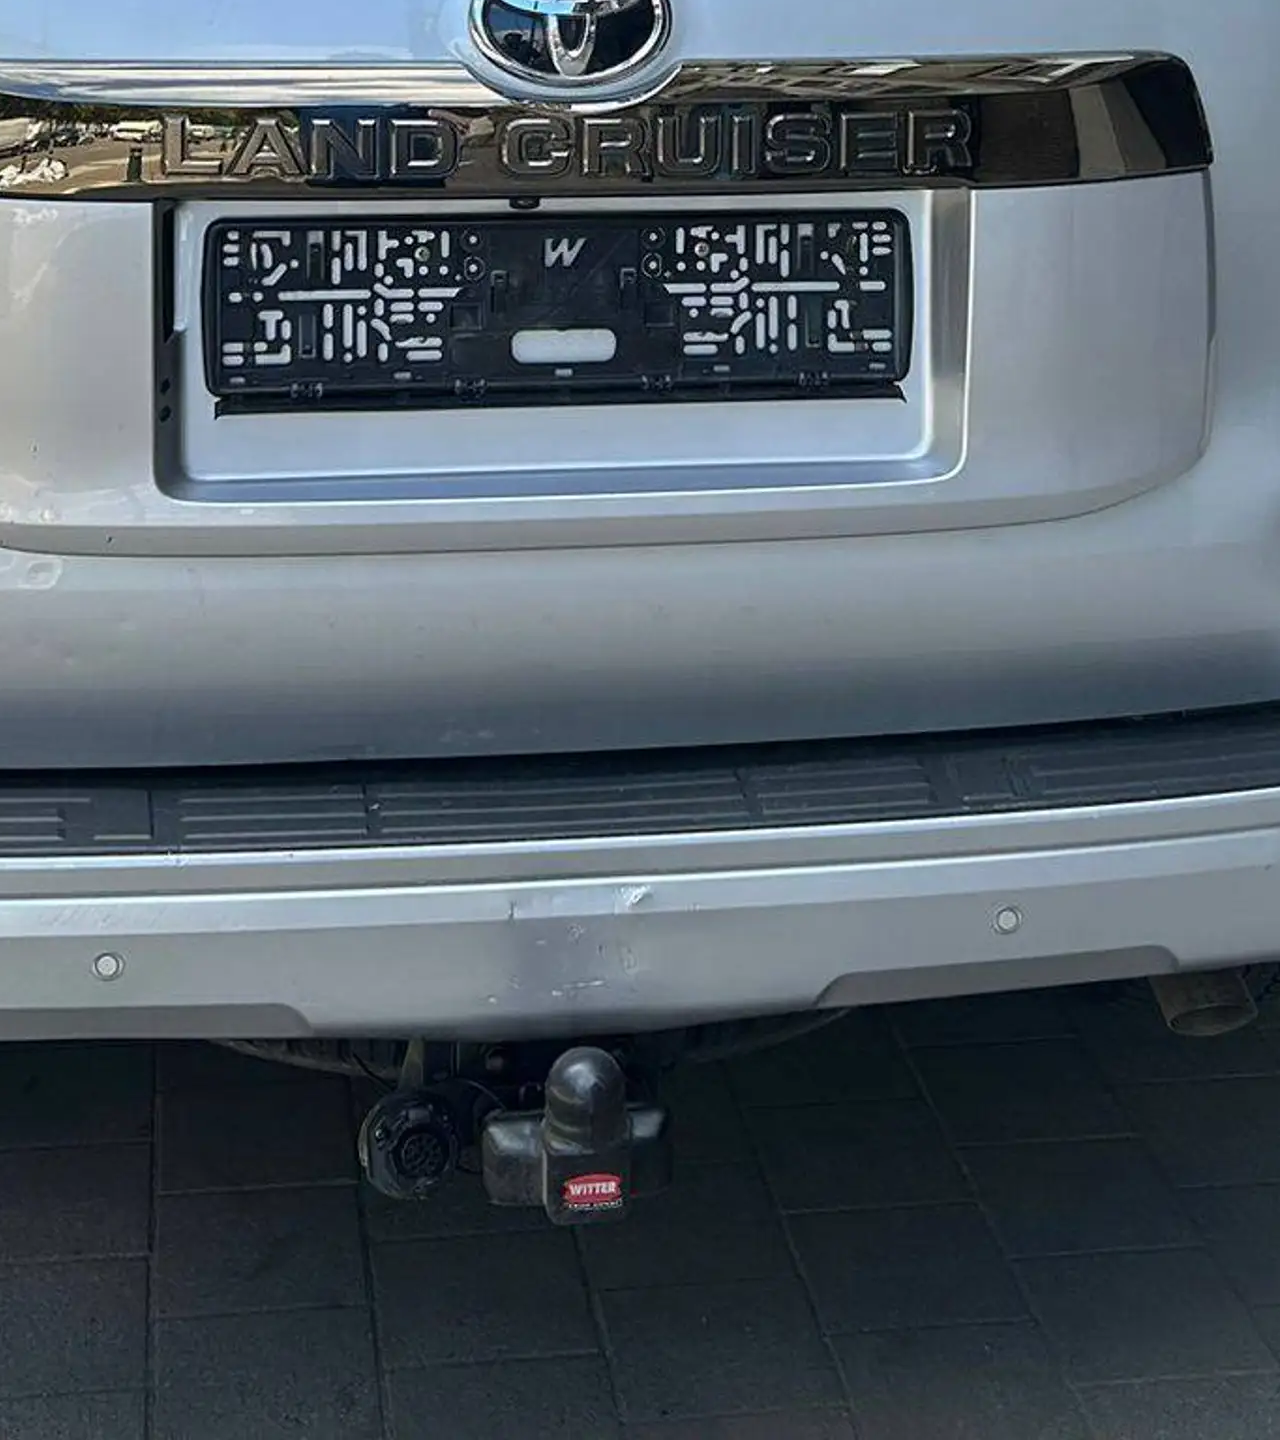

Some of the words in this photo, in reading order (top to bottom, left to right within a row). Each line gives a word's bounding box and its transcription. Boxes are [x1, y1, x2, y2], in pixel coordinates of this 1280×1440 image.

[162, 116, 464, 179] LAND
[501, 107, 974, 178] CRUISER
[568, 1180, 617, 1196] WITTER
